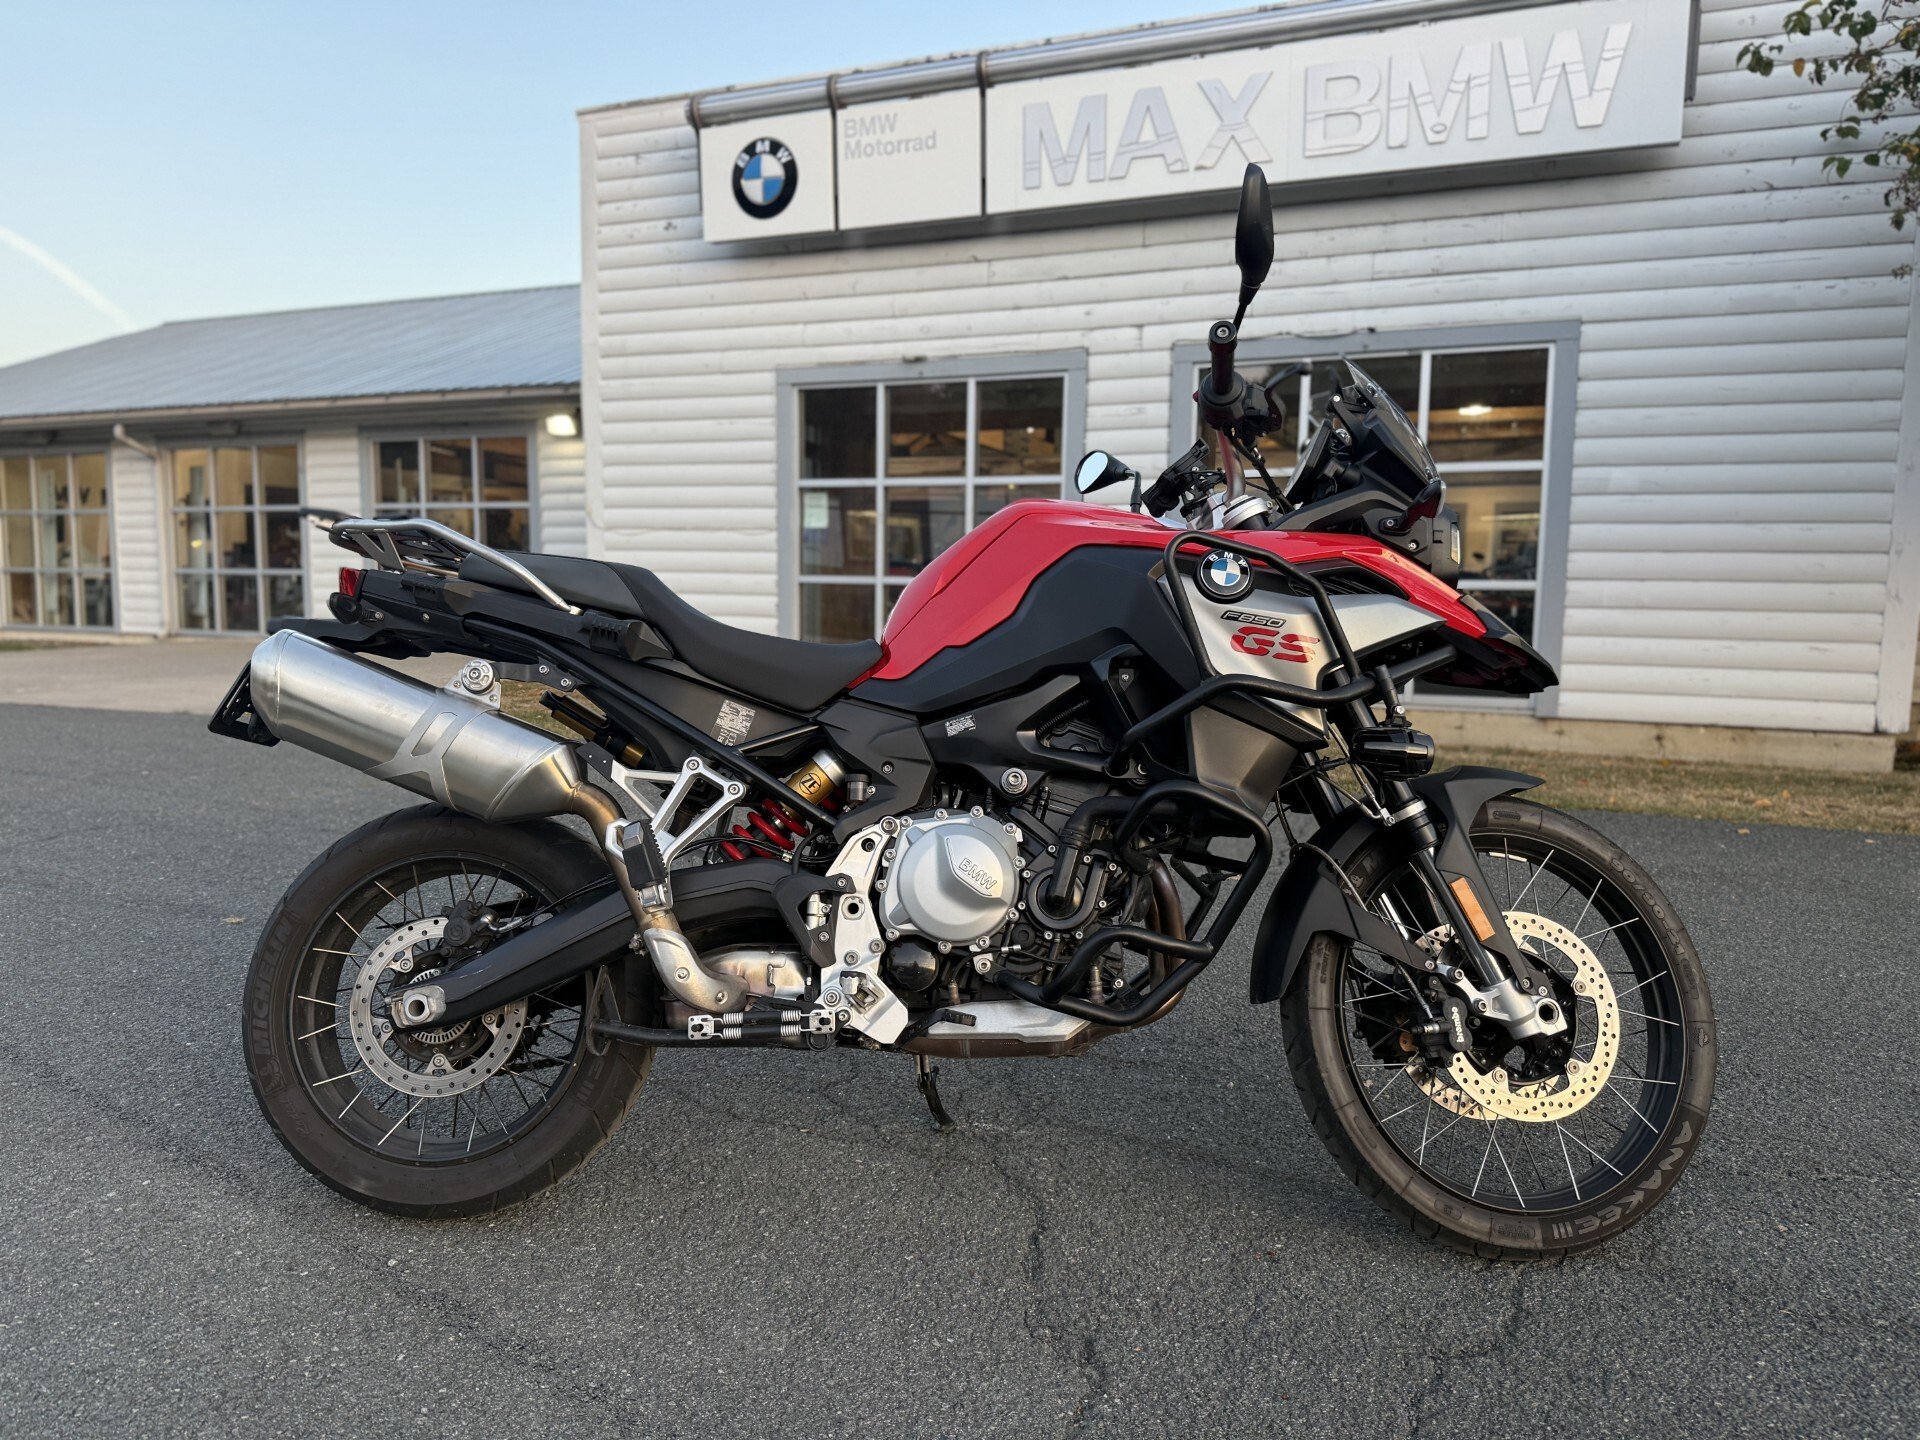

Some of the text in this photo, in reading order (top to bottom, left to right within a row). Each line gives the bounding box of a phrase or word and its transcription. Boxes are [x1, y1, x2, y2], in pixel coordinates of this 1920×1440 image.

[1022, 22, 1633, 190] MAX BMW
[843, 113, 898, 138] BMW
[736, 140, 792, 168] BMW
[844, 130, 938, 160] Motorrad
[1208, 551, 1248, 567] BMW
[1231, 626, 1320, 663] GS
[959, 858, 997, 889] BMW
[252, 916, 293, 1056] MICHELIN
[1452, 1006, 1464, 1042] brembo
